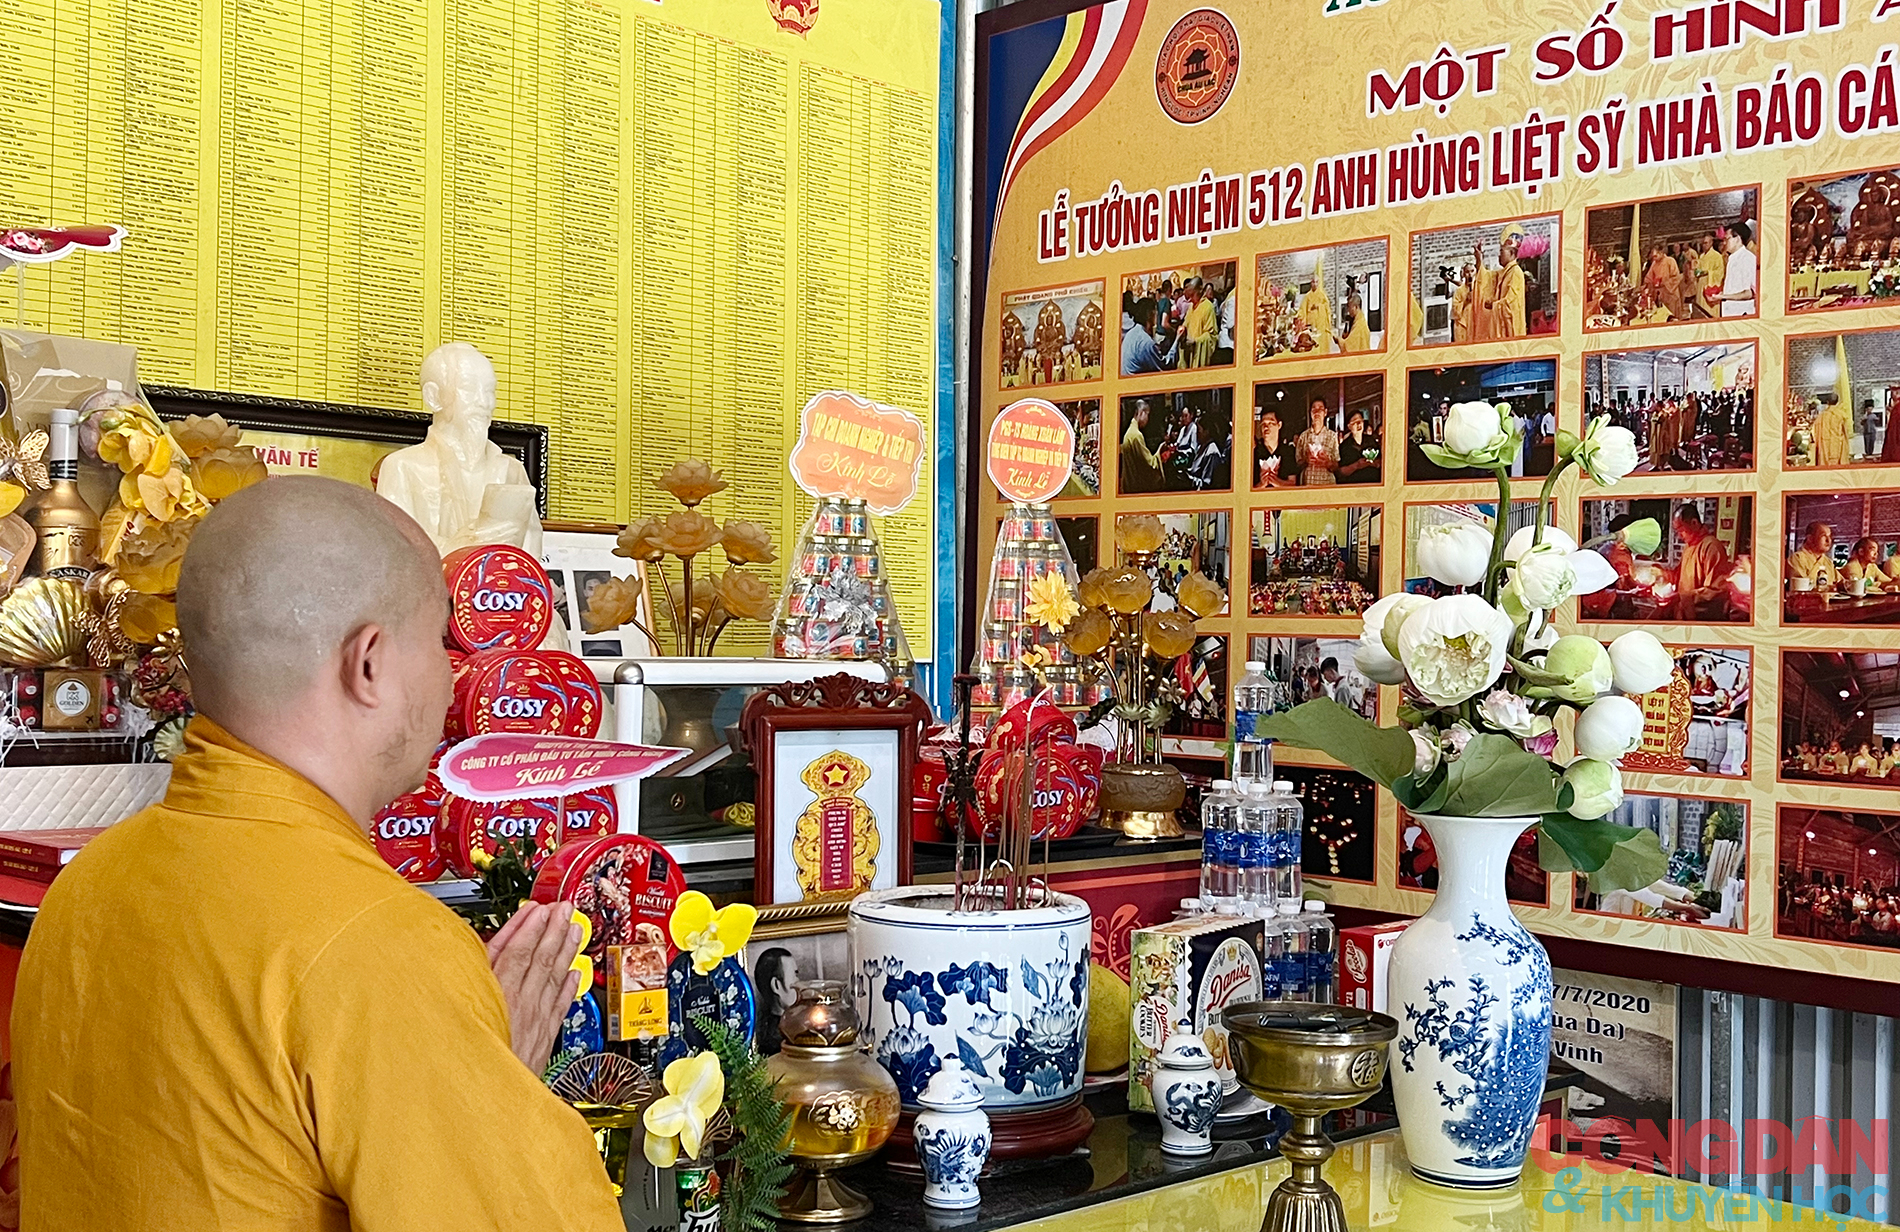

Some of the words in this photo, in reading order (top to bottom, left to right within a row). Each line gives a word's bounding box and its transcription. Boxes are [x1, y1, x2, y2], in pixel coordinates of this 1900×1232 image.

[1370, 47, 1506, 114] MỘT
[1535, 4, 1624, 80] SỐ
[1040, 194, 1068, 259] LỄ
[1076, 184, 1159, 252] TƯỞNG
[1168, 173, 1240, 245] NIỆM
[1250, 167, 1303, 226] 512
[1312, 153, 1378, 215] ANH
[1389, 133, 1480, 203] HÙNG
[1492, 113, 1566, 194] LIỆT
[1577, 99, 1627, 173] SỸ
[1638, 83, 1722, 165] NHÀ
[1736, 69, 1823, 150] BÁO
[1839, 50, 1900, 134] CÁ
[255, 446, 292, 466] VĂN
[298, 447, 319, 468] TẾ
[816, 451, 866, 485] Kính
[867, 465, 897, 489] Lễ
[1004, 467, 1033, 488] Kính
[1033, 471, 1051, 490] Lễ
[472, 589, 529, 612] COSY
[491, 696, 548, 718] COSY
[460, 757, 487, 771] CÔNG
[487, 756, 500, 767] TY
[500, 753, 514, 766] CỔ
[514, 749, 541, 763] PHẦN
[515, 765, 566, 787] Kính
[570, 760, 606, 779] Lễ
[1029, 789, 1064, 809] COSY
[379, 816, 435, 840] COSY
[487, 816, 543, 838] COSY
[635, 893, 673, 910] BISCUIT
[1206, 958, 1252, 1012] Danisa
[1586, 1017, 1625, 1041] Da)
[1554, 1040, 1604, 1065] Vinh
